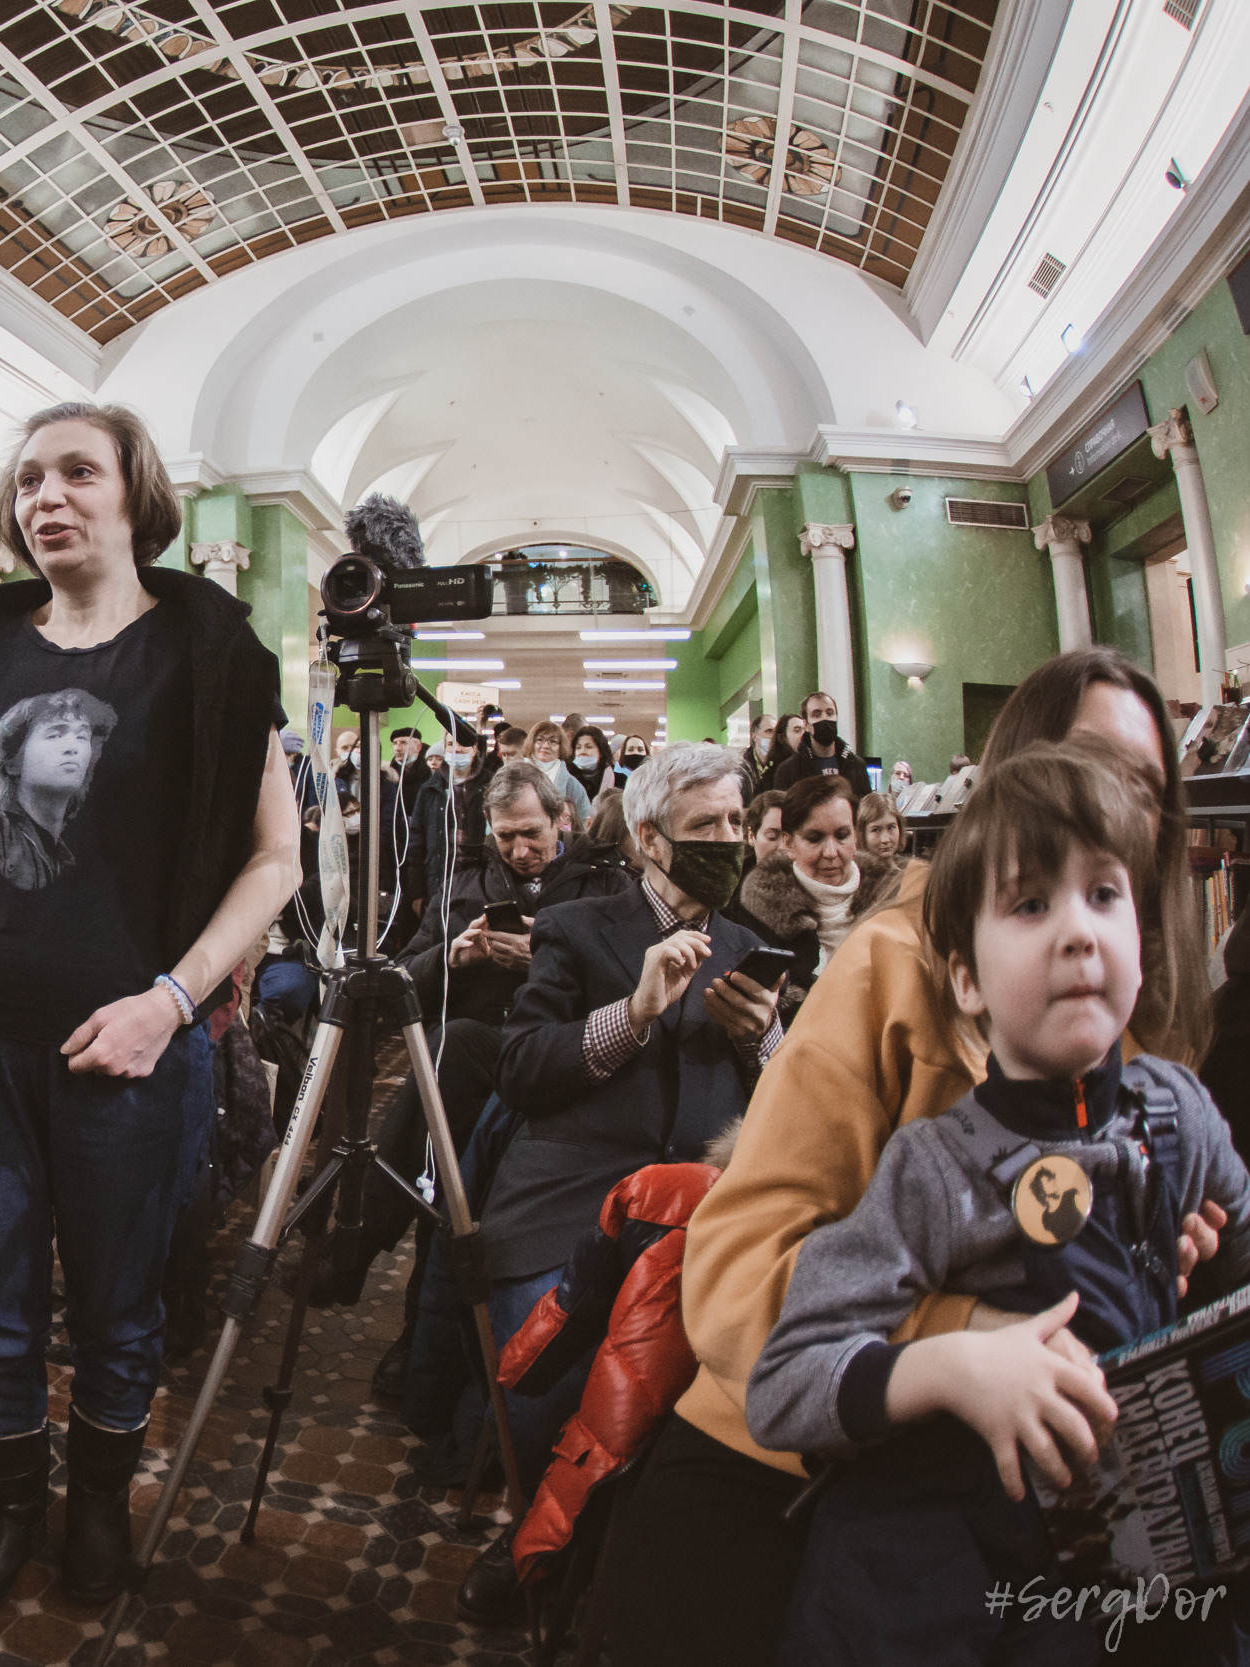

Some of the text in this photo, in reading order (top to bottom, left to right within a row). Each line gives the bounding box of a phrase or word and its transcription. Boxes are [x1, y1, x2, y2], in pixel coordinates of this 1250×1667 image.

[449, 577, 465, 585] HD
[284, 1057, 318, 1145] Velbon CX 444
[1145, 1358, 1210, 1468] КОНЕЦ
